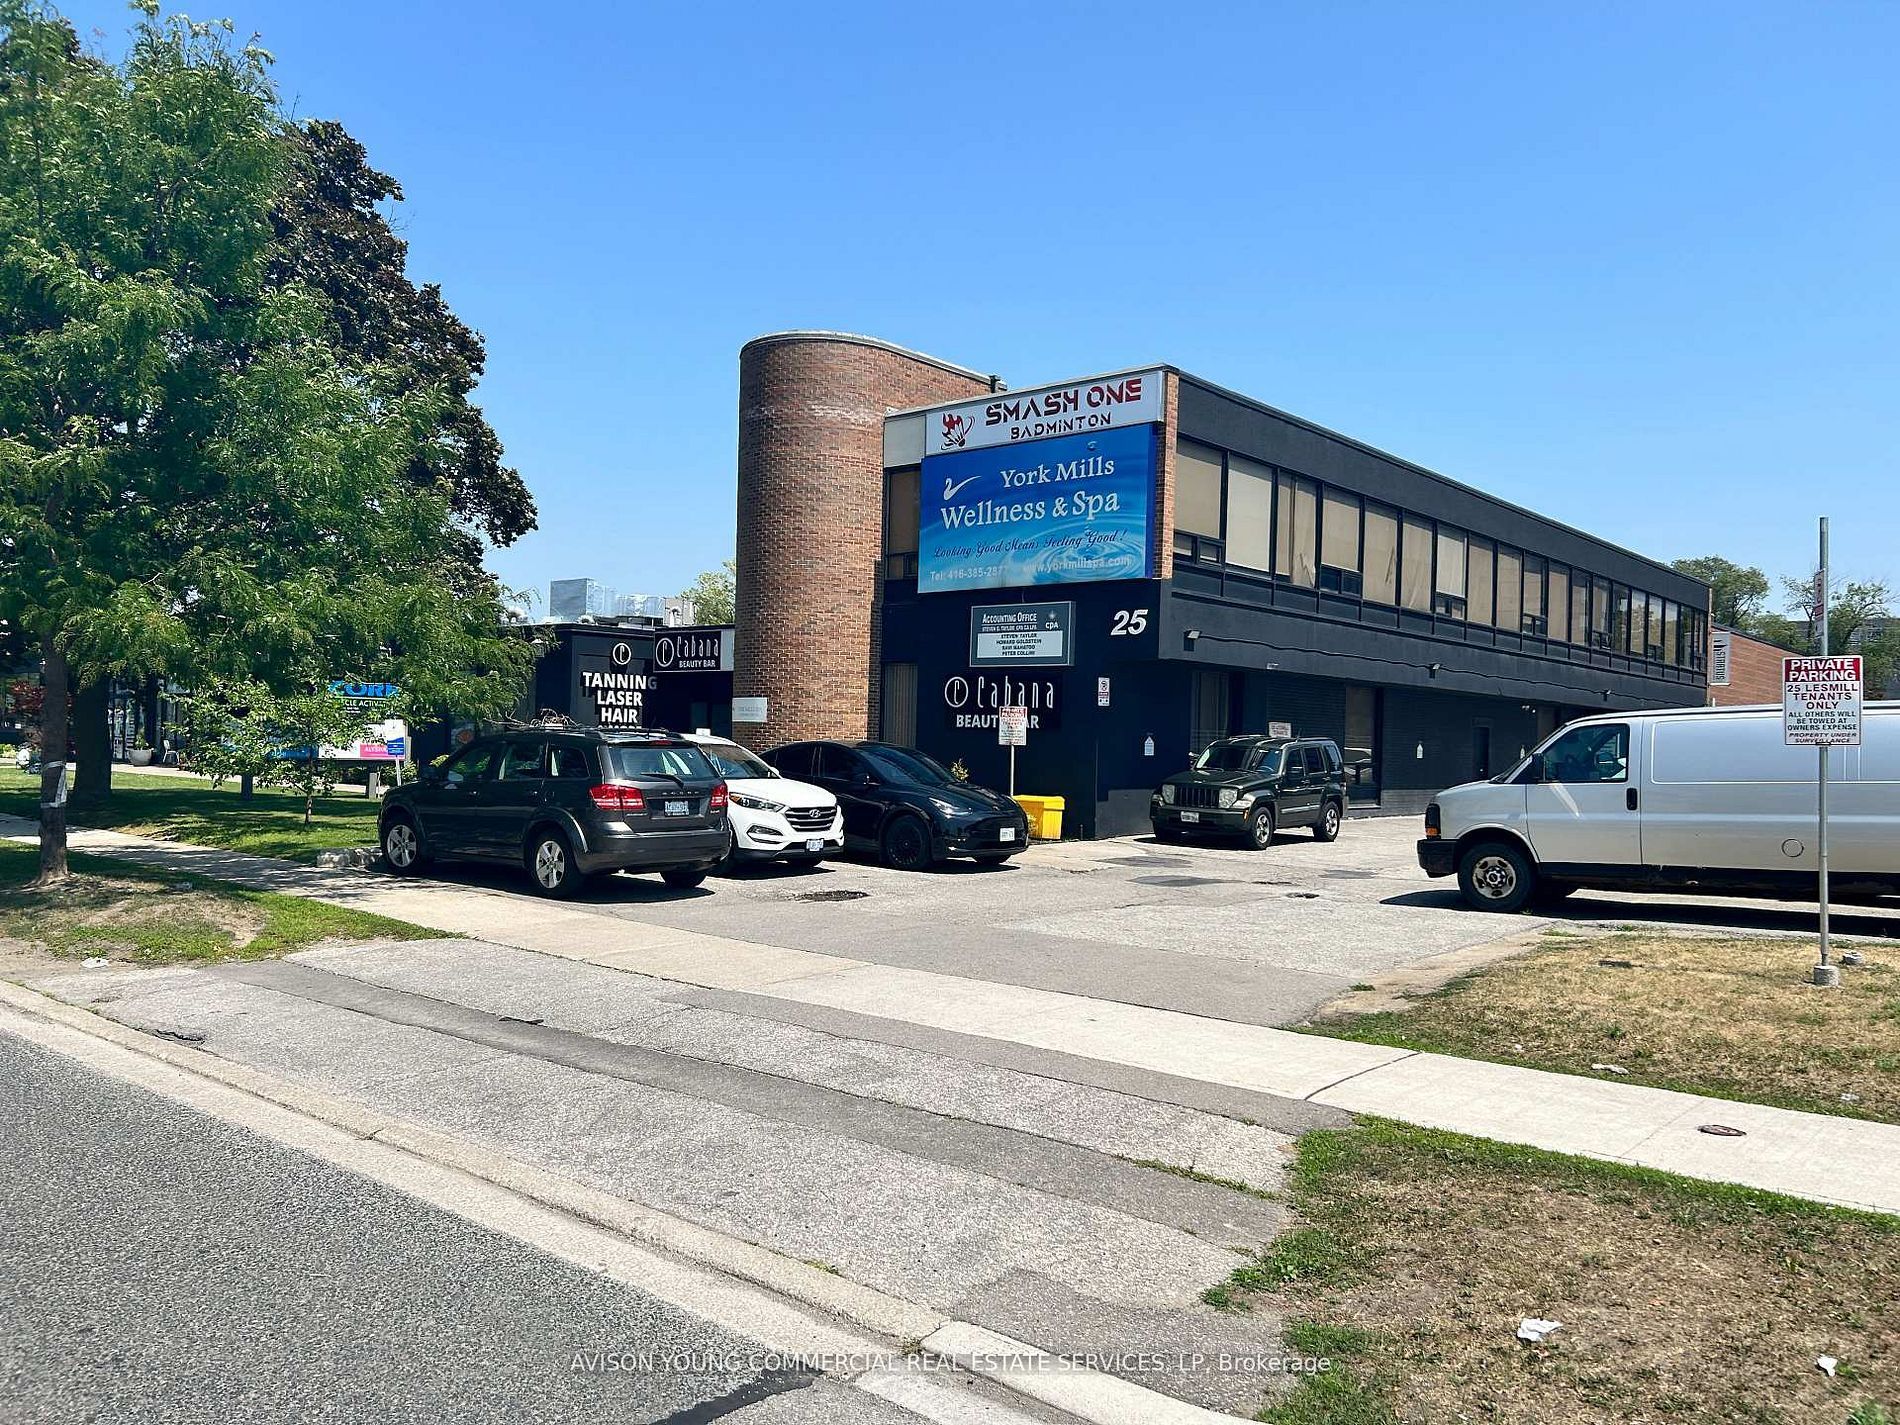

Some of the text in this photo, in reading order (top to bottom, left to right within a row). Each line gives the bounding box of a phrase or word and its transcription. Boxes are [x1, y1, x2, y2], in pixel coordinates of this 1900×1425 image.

[985, 378, 1142, 426] SMASH ONE
[1010, 412, 1112, 440] BADMINTON
[1000, 456, 1115, 488] York Mills
[940, 491, 1120, 530] Wellness & Spa
[934, 545, 972, 558] Looking
[975, 541, 1004, 558] Good
[1044, 536, 1082, 549] Feeling
[1110, 608, 1149, 636] 25
[677, 635, 719, 658] Cabana
[679, 659, 716, 668] BEAUTY BAR
[1790, 658, 1855, 670] PRIVATE
[582, 671, 657, 690] TANNING
[1789, 670, 1857, 681] PARKING
[977, 675, 1054, 709] Cabana
[1787, 683, 1858, 692] 25 LESMILL
[1793, 692, 1852, 700] TENANTS
[597, 690, 643, 706] LASER
[1806, 701, 1839, 709] ONLY
[601, 707, 638, 723] HAIR
[956, 714, 998, 728] BEAUT
